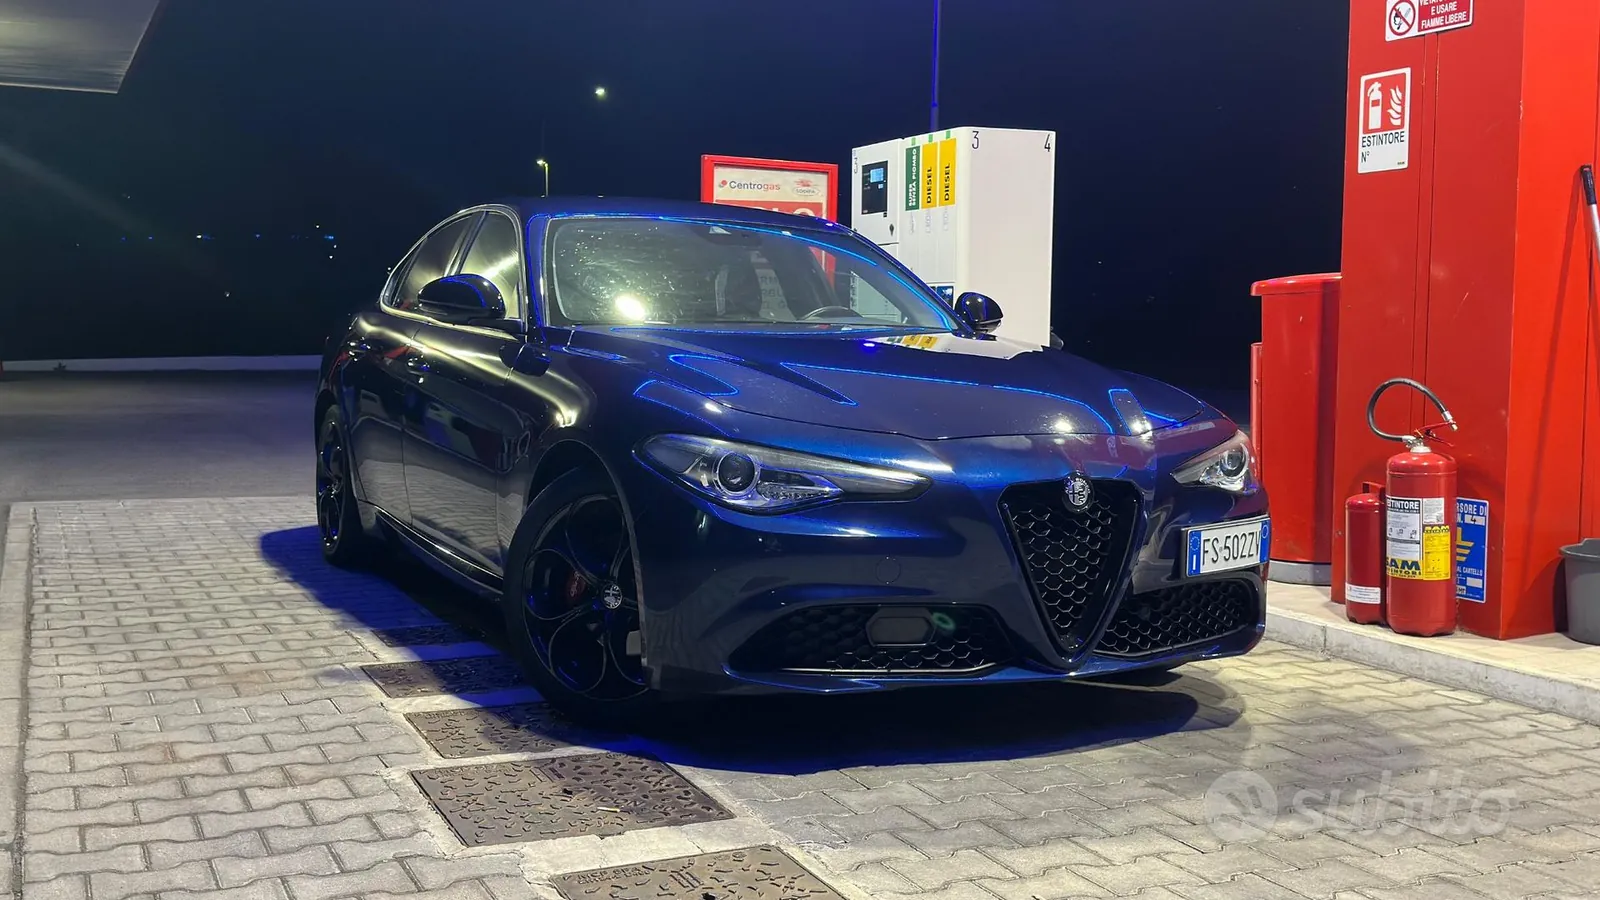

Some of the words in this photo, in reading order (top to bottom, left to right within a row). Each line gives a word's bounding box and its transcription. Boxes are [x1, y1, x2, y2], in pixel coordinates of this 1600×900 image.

[1431, 6, 1436, 15] E
[1436, 1, 1458, 14] USARE
[1421, 16, 1445, 29] FIAMME
[1445, 11, 1467, 25] LIBERE
[971, 130, 980, 150] 3
[1044, 133, 1051, 153] 4
[1361, 131, 1406, 148] ESTINTORE
[729, 180, 781, 191] Centrogas
[1202, 537, 1219, 566] FS
